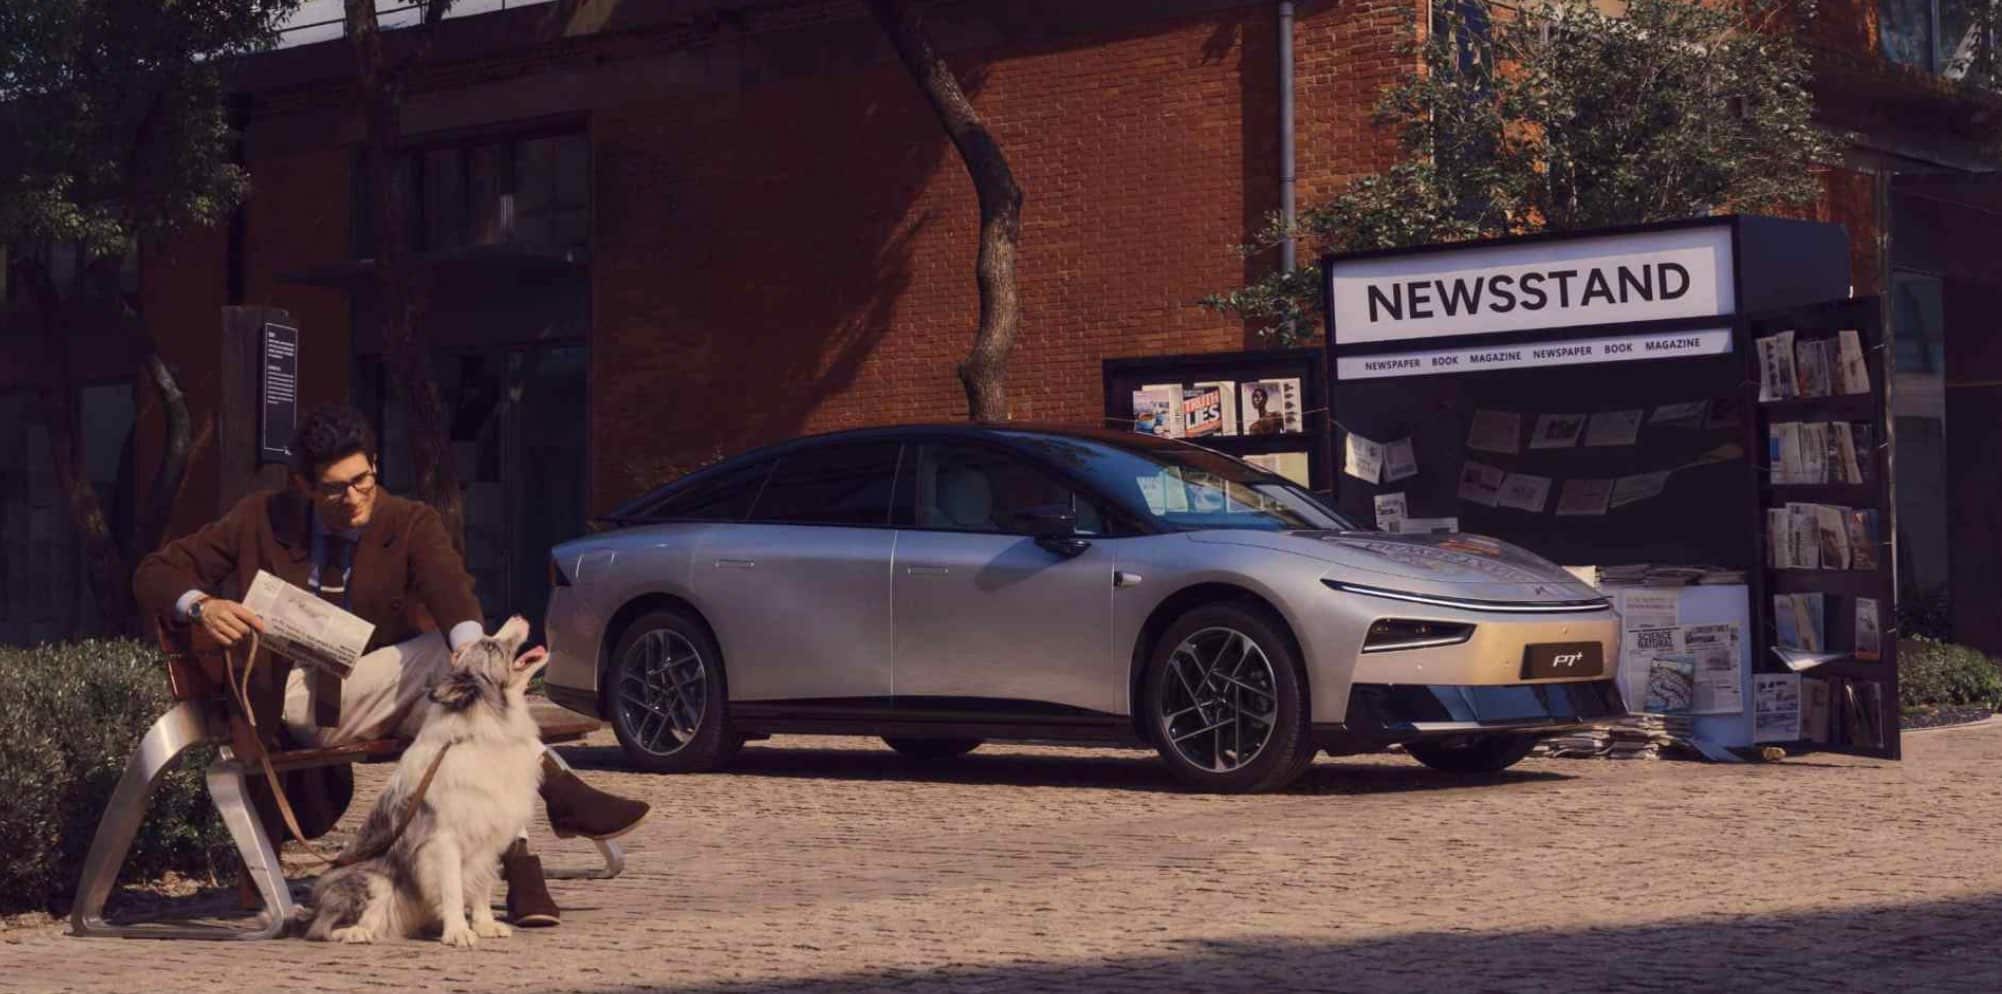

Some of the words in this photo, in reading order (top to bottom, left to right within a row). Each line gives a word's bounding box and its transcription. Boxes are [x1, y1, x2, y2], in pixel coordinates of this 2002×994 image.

[1367, 262, 1690, 322] NEWSSTAND
[1364, 358, 1421, 371] NEWSPAPER
[1431, 355, 1459, 367] BOOK
[1469, 351, 1521, 363] MAGAZINE
[1532, 345, 1593, 359] NEWSPAPER
[1603, 342, 1633, 354] BOOK
[1645, 337, 1701, 351] MAGAZINE
[1184, 403, 1220, 430] LIES
[1637, 630, 1673, 641] SCIENCE
